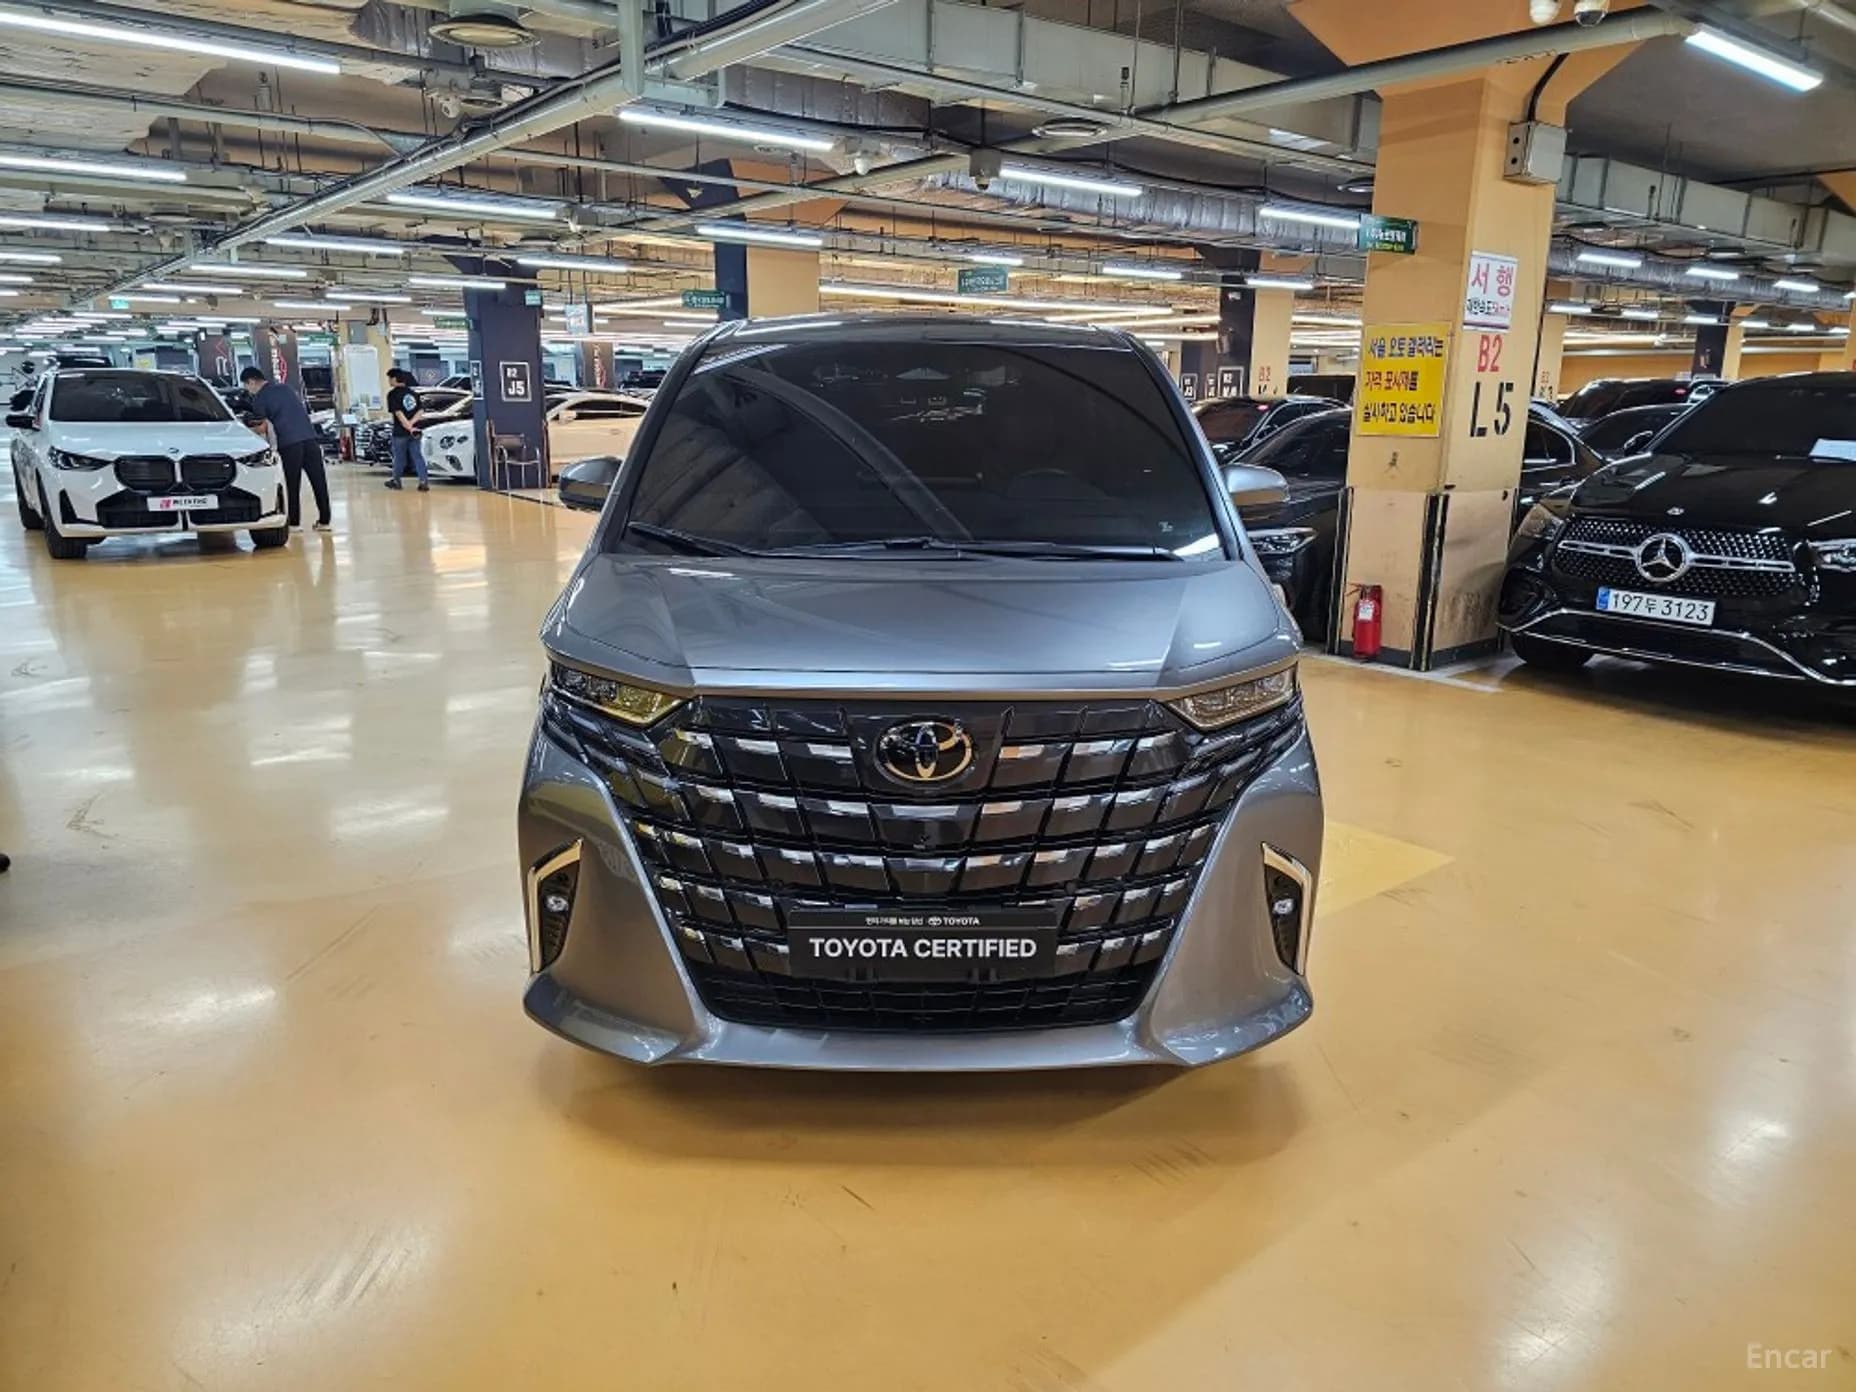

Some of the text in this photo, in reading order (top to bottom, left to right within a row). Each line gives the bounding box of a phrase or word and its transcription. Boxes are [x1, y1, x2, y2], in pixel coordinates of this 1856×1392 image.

[1477, 335, 1502, 372] B2
[508, 380, 526, 395] J5
[1470, 381, 1514, 437] L5
[943, 917, 980, 926] TOYOTA
[809, 938, 1037, 957] TOYOTA CERTIFIED
